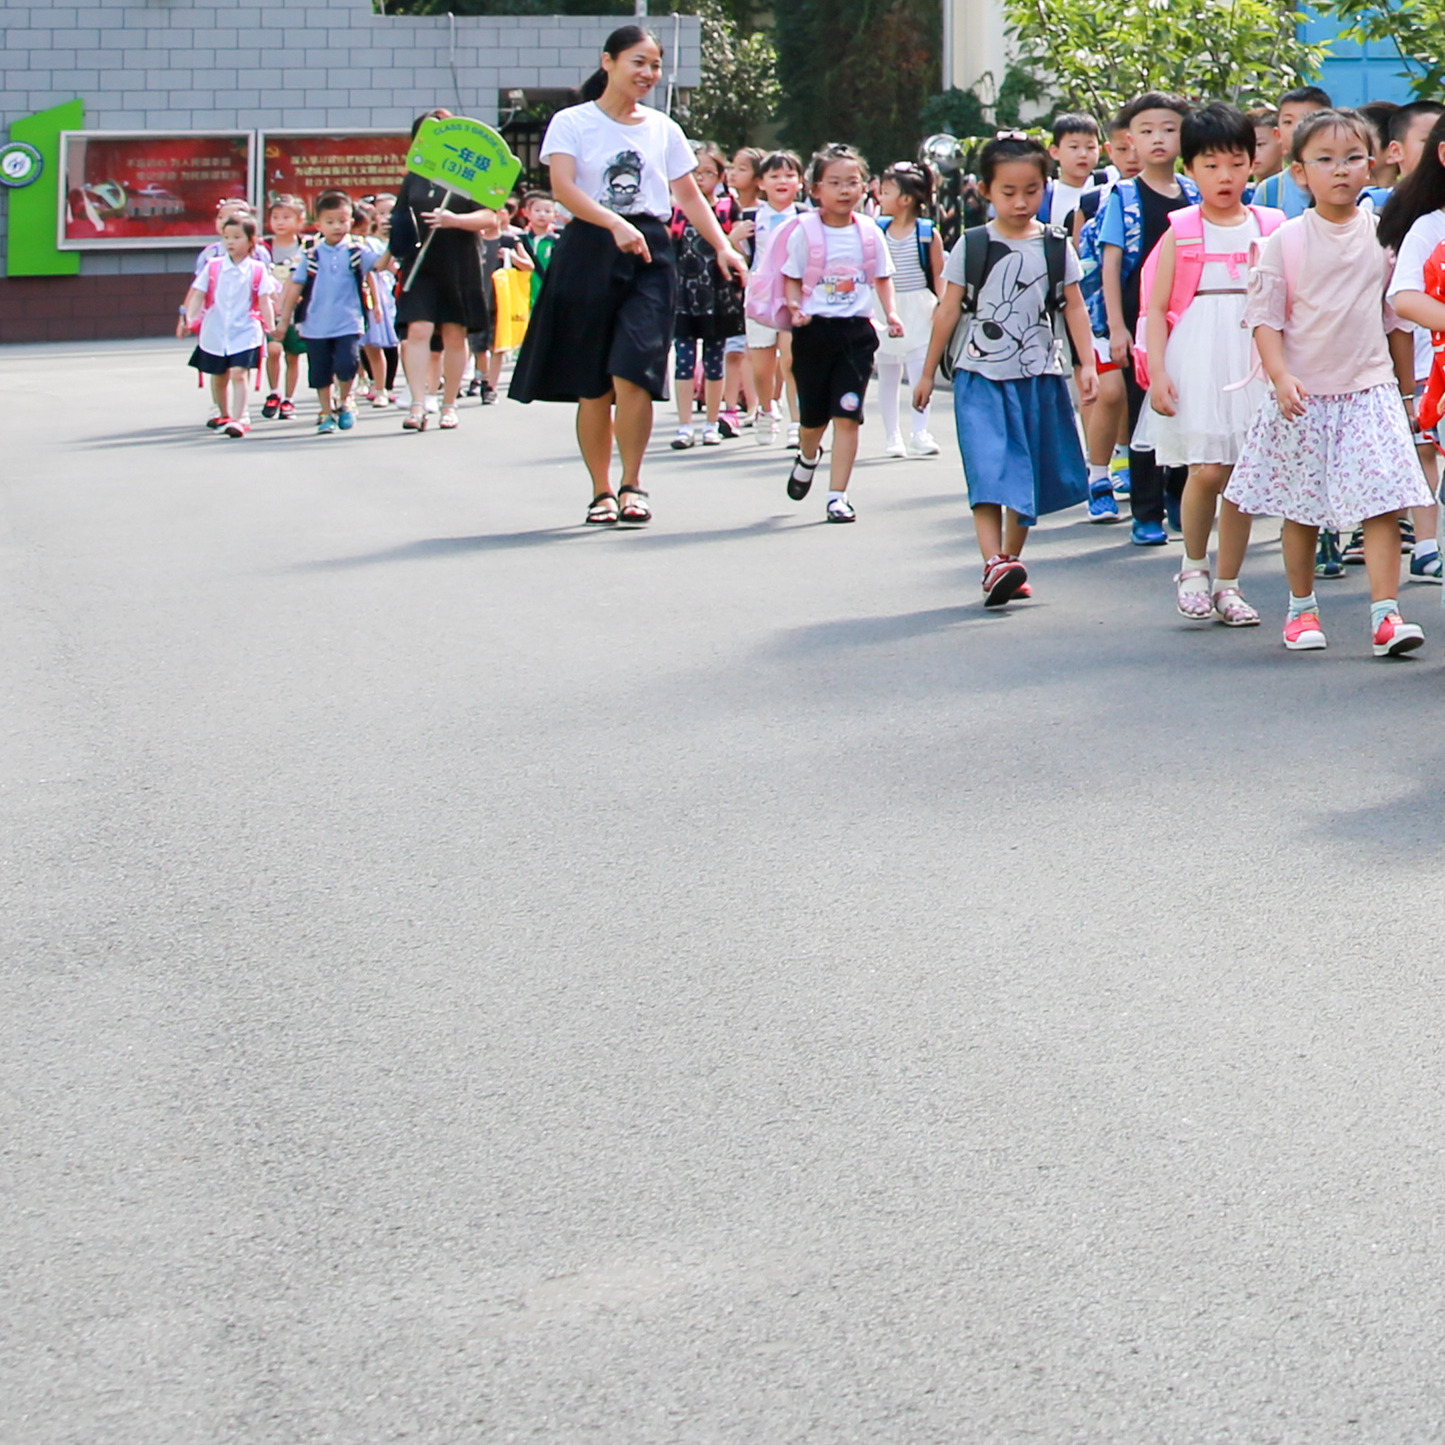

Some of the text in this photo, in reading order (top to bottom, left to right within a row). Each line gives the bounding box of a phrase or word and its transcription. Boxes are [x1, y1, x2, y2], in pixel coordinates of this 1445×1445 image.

[433, 123, 508, 167] CLASS 3 GRADE ONE
[443, 143, 492, 172] 一年级
[442, 158, 477, 182] (3)班
